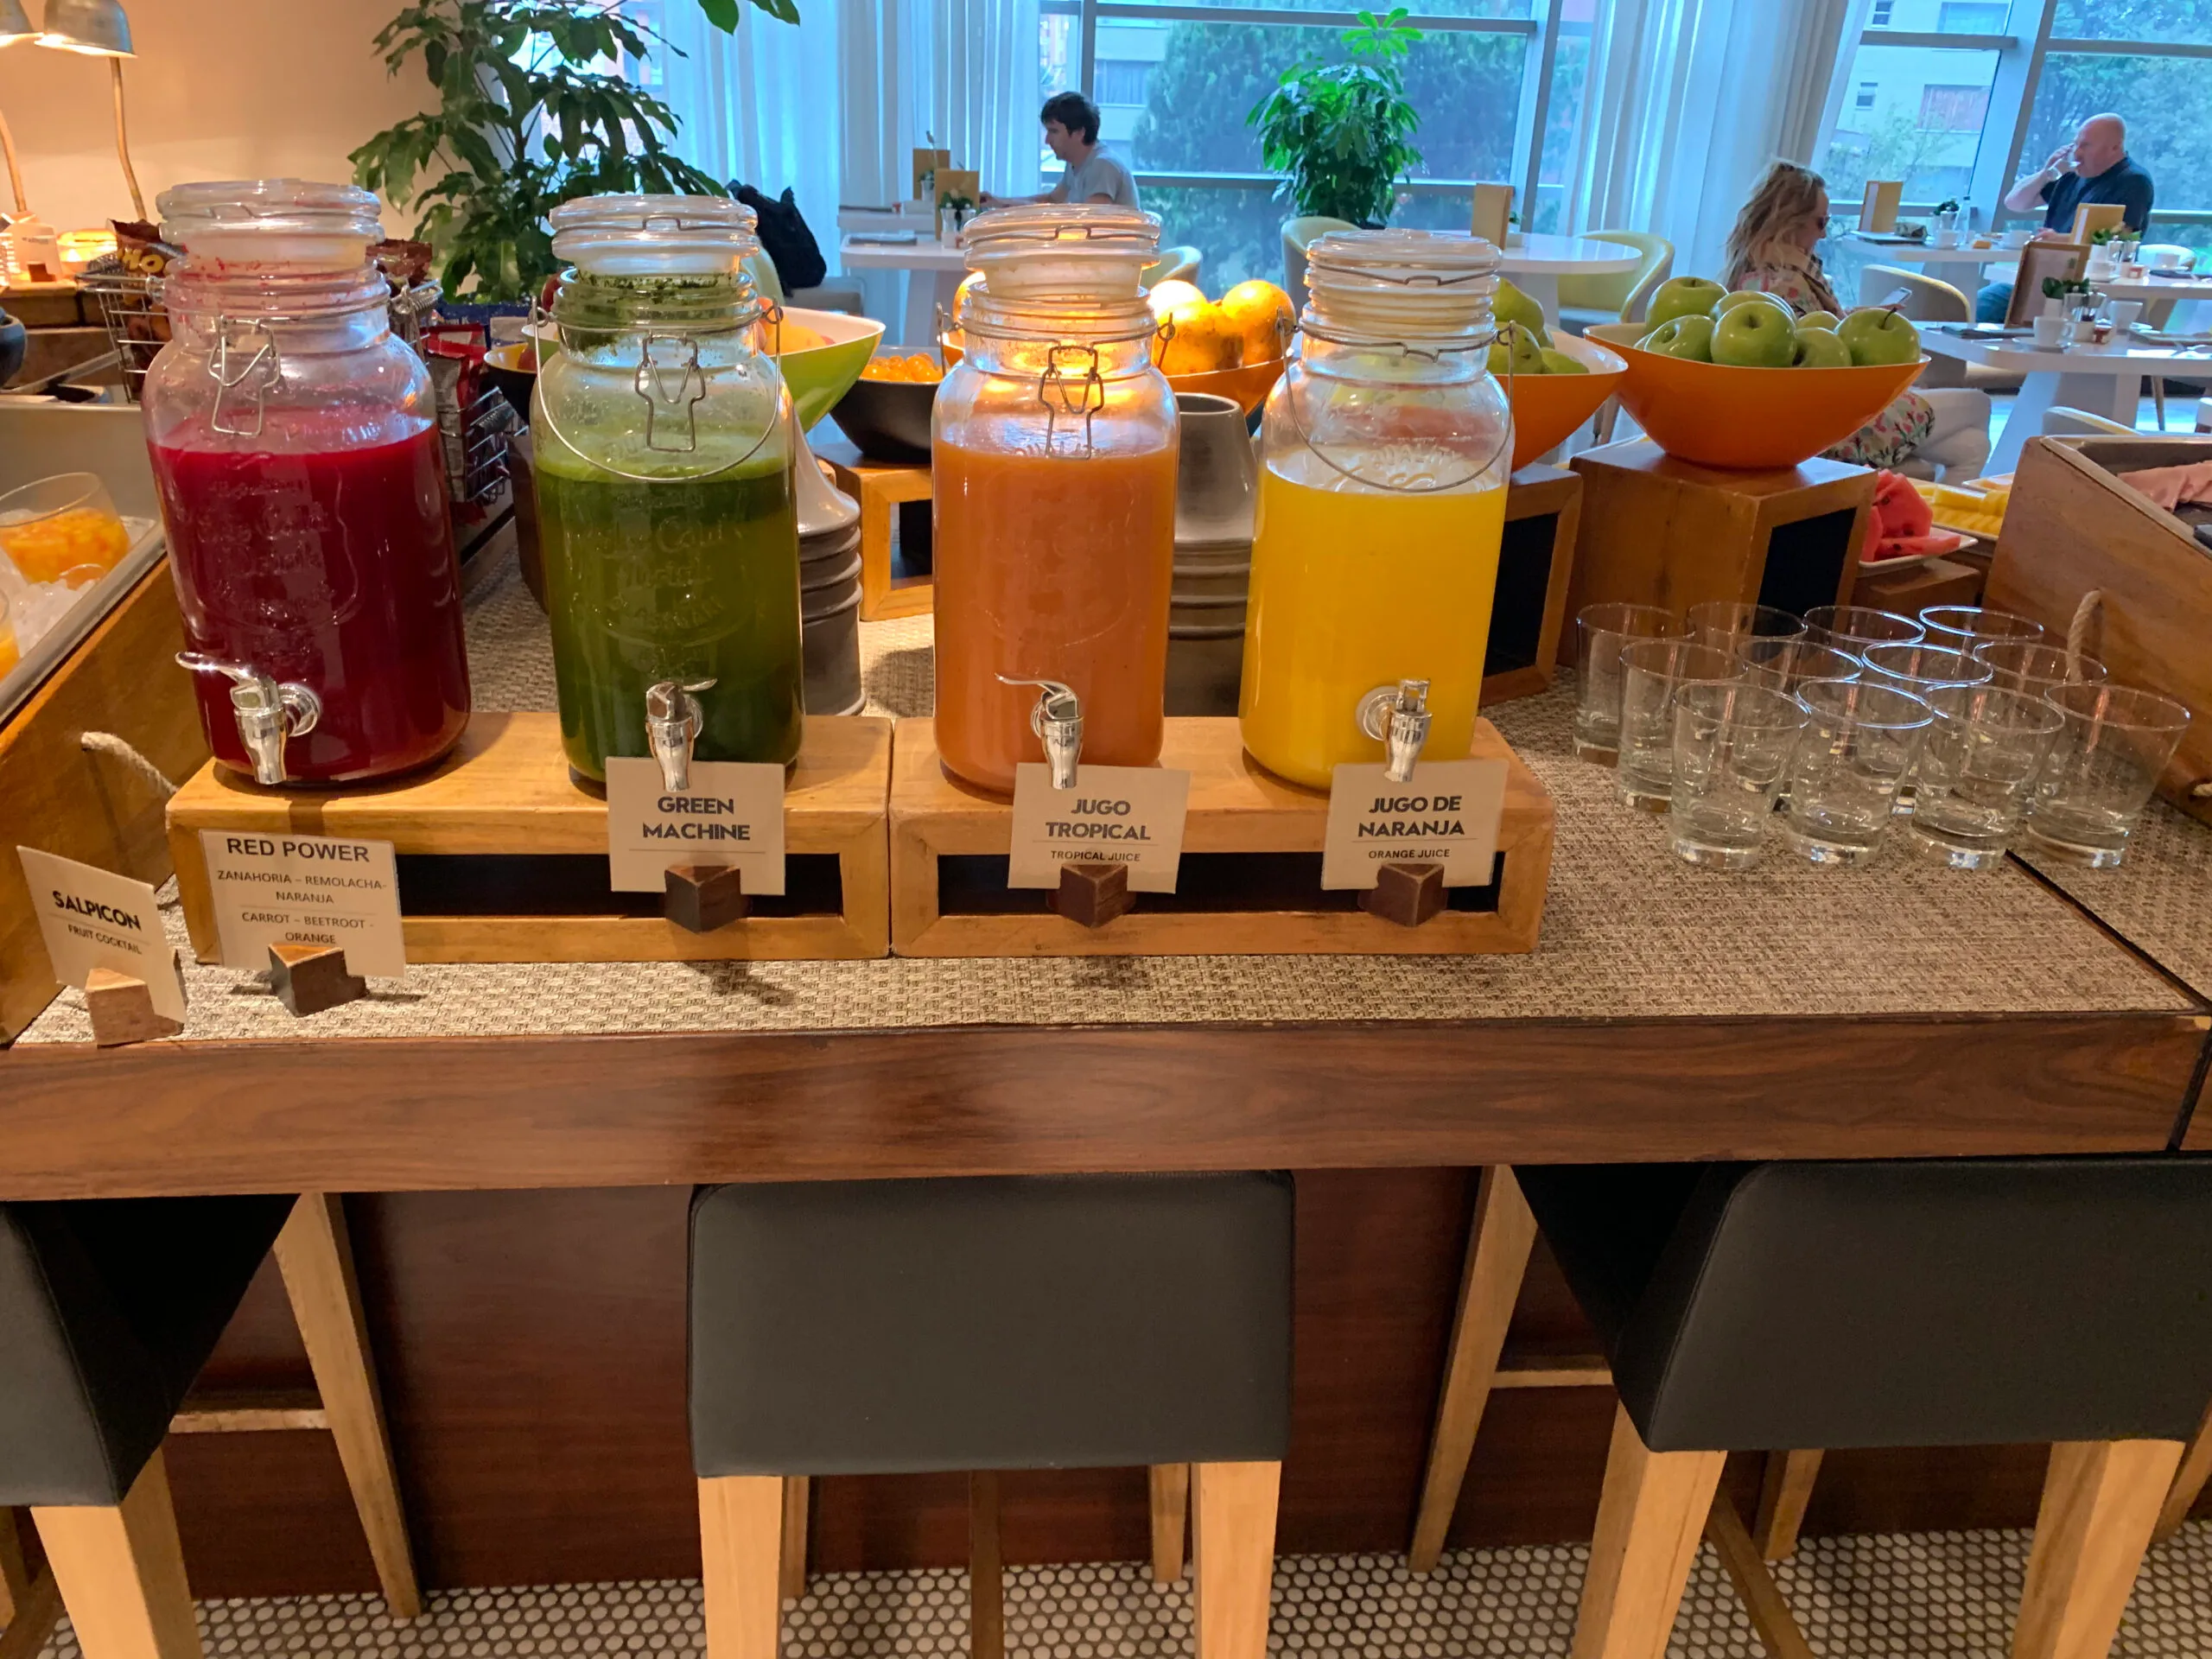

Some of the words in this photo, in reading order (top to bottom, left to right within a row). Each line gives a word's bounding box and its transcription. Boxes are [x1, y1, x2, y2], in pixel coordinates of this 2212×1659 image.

[657, 796, 734, 815] GREEN
[1071, 798, 1131, 816] JUGO
[1368, 796, 1428, 814] JUGO
[1433, 795, 1463, 811] DE
[642, 822, 751, 841] MACHINE
[1046, 822, 1151, 841] TROPICAL
[1357, 820, 1465, 838] NARANJA
[226, 837, 275, 856] RED
[283, 841, 371, 862] POWER
[1051, 850, 1105, 861] TROPICAL
[1108, 851, 1141, 861] JUICE
[1368, 849, 1415, 860] ORANGE
[1417, 849, 1451, 859] JUICE
[217, 869, 292, 884] ZANAHORIA
[276, 891, 334, 905] NARANJA
[52, 890, 143, 933] SALPICON
[241, 912, 290, 925] CARROT
[303, 916, 365, 930] BEETROOT
[67, 923, 93, 939] FRUIT
[95, 932, 143, 956] COCKTAIL
[284, 931, 336, 944] ORANGE
